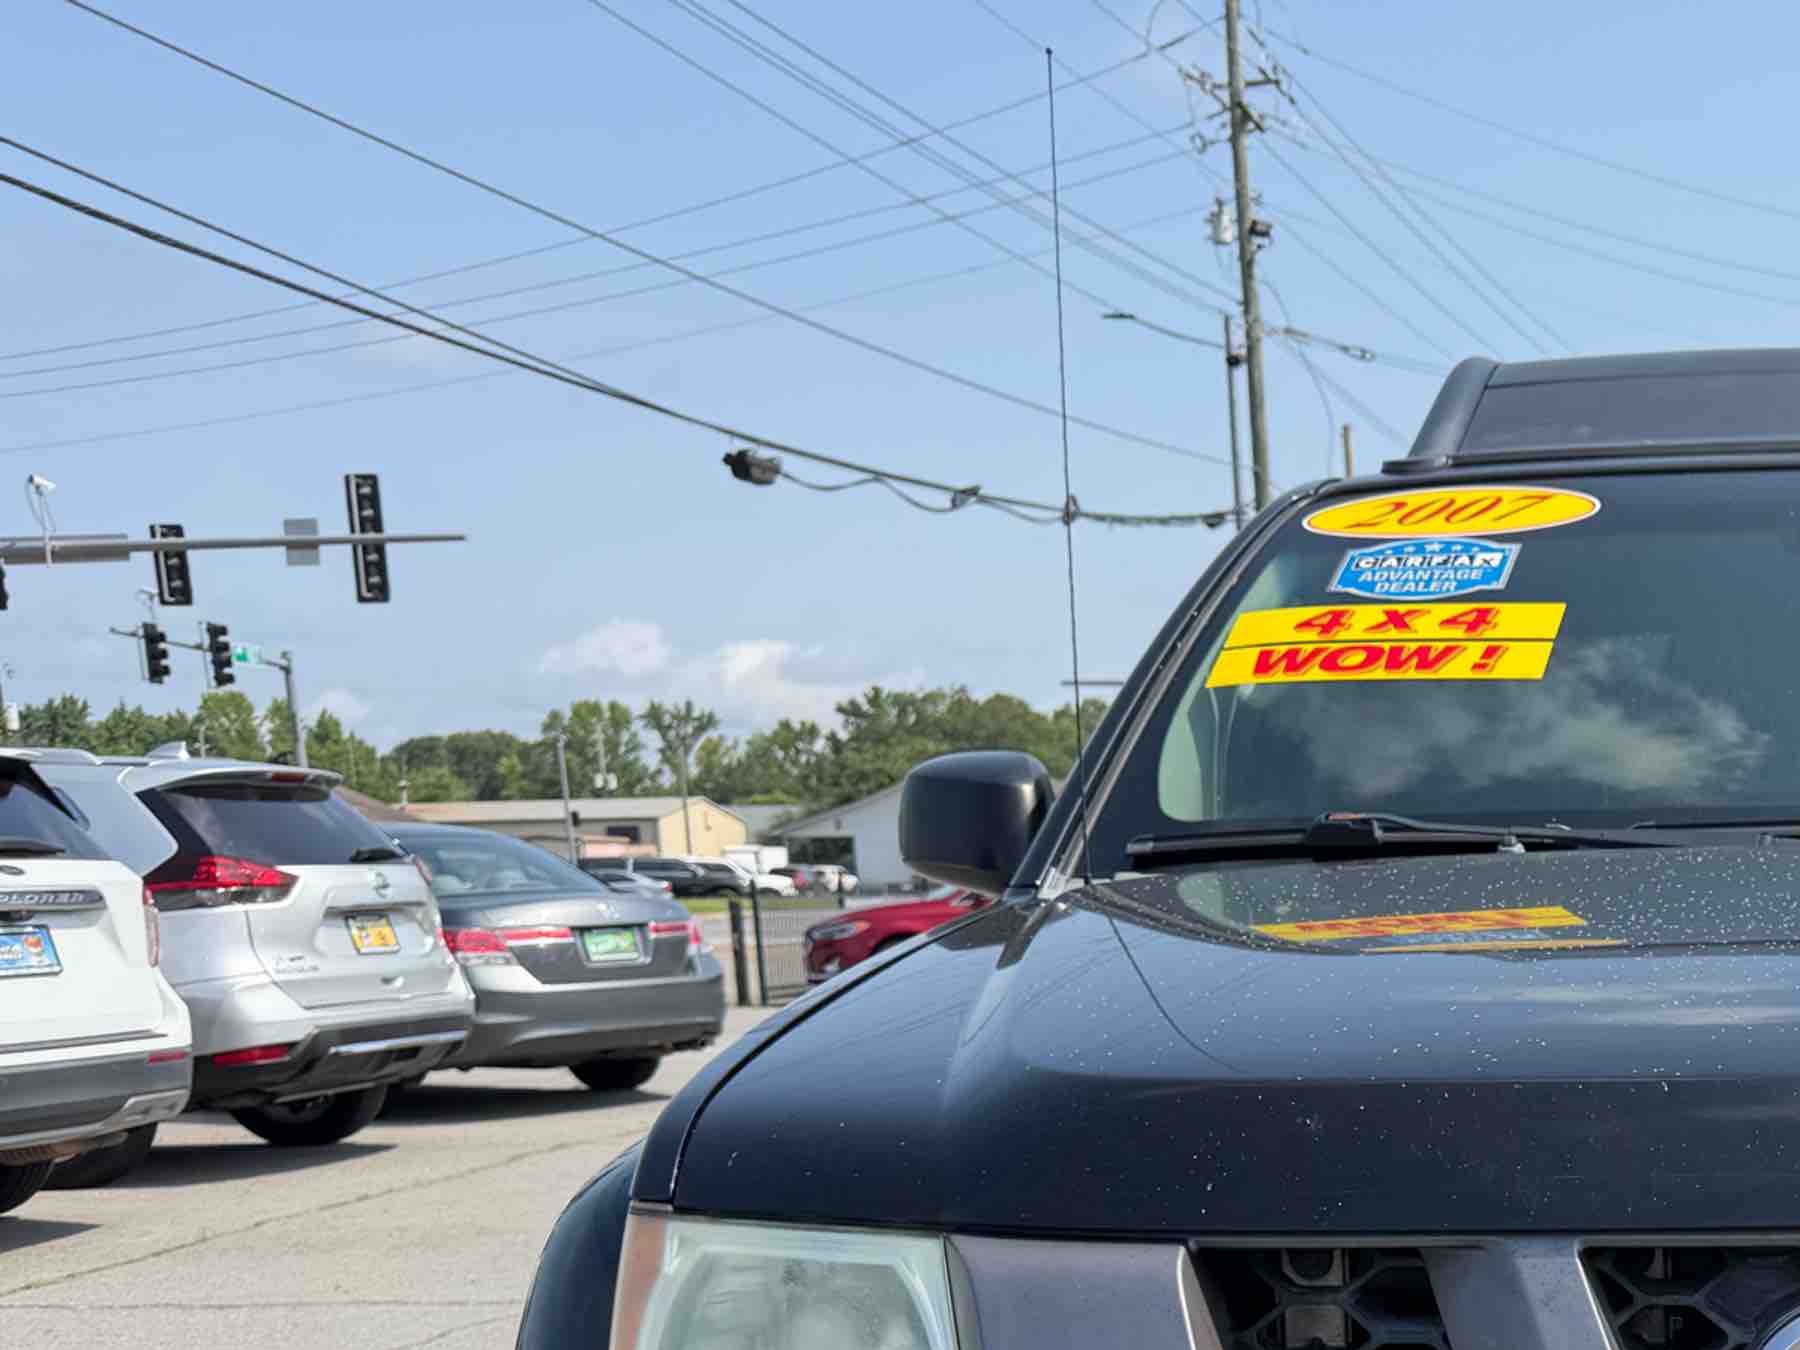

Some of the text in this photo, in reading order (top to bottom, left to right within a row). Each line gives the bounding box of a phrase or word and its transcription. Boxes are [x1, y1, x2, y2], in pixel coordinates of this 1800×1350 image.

[1345, 494, 1553, 528] 2007
[1356, 552, 1503, 570] CARFAX
[1359, 568, 1484, 582] ADVANTAGE
[1374, 581, 1458, 593] DEALER
